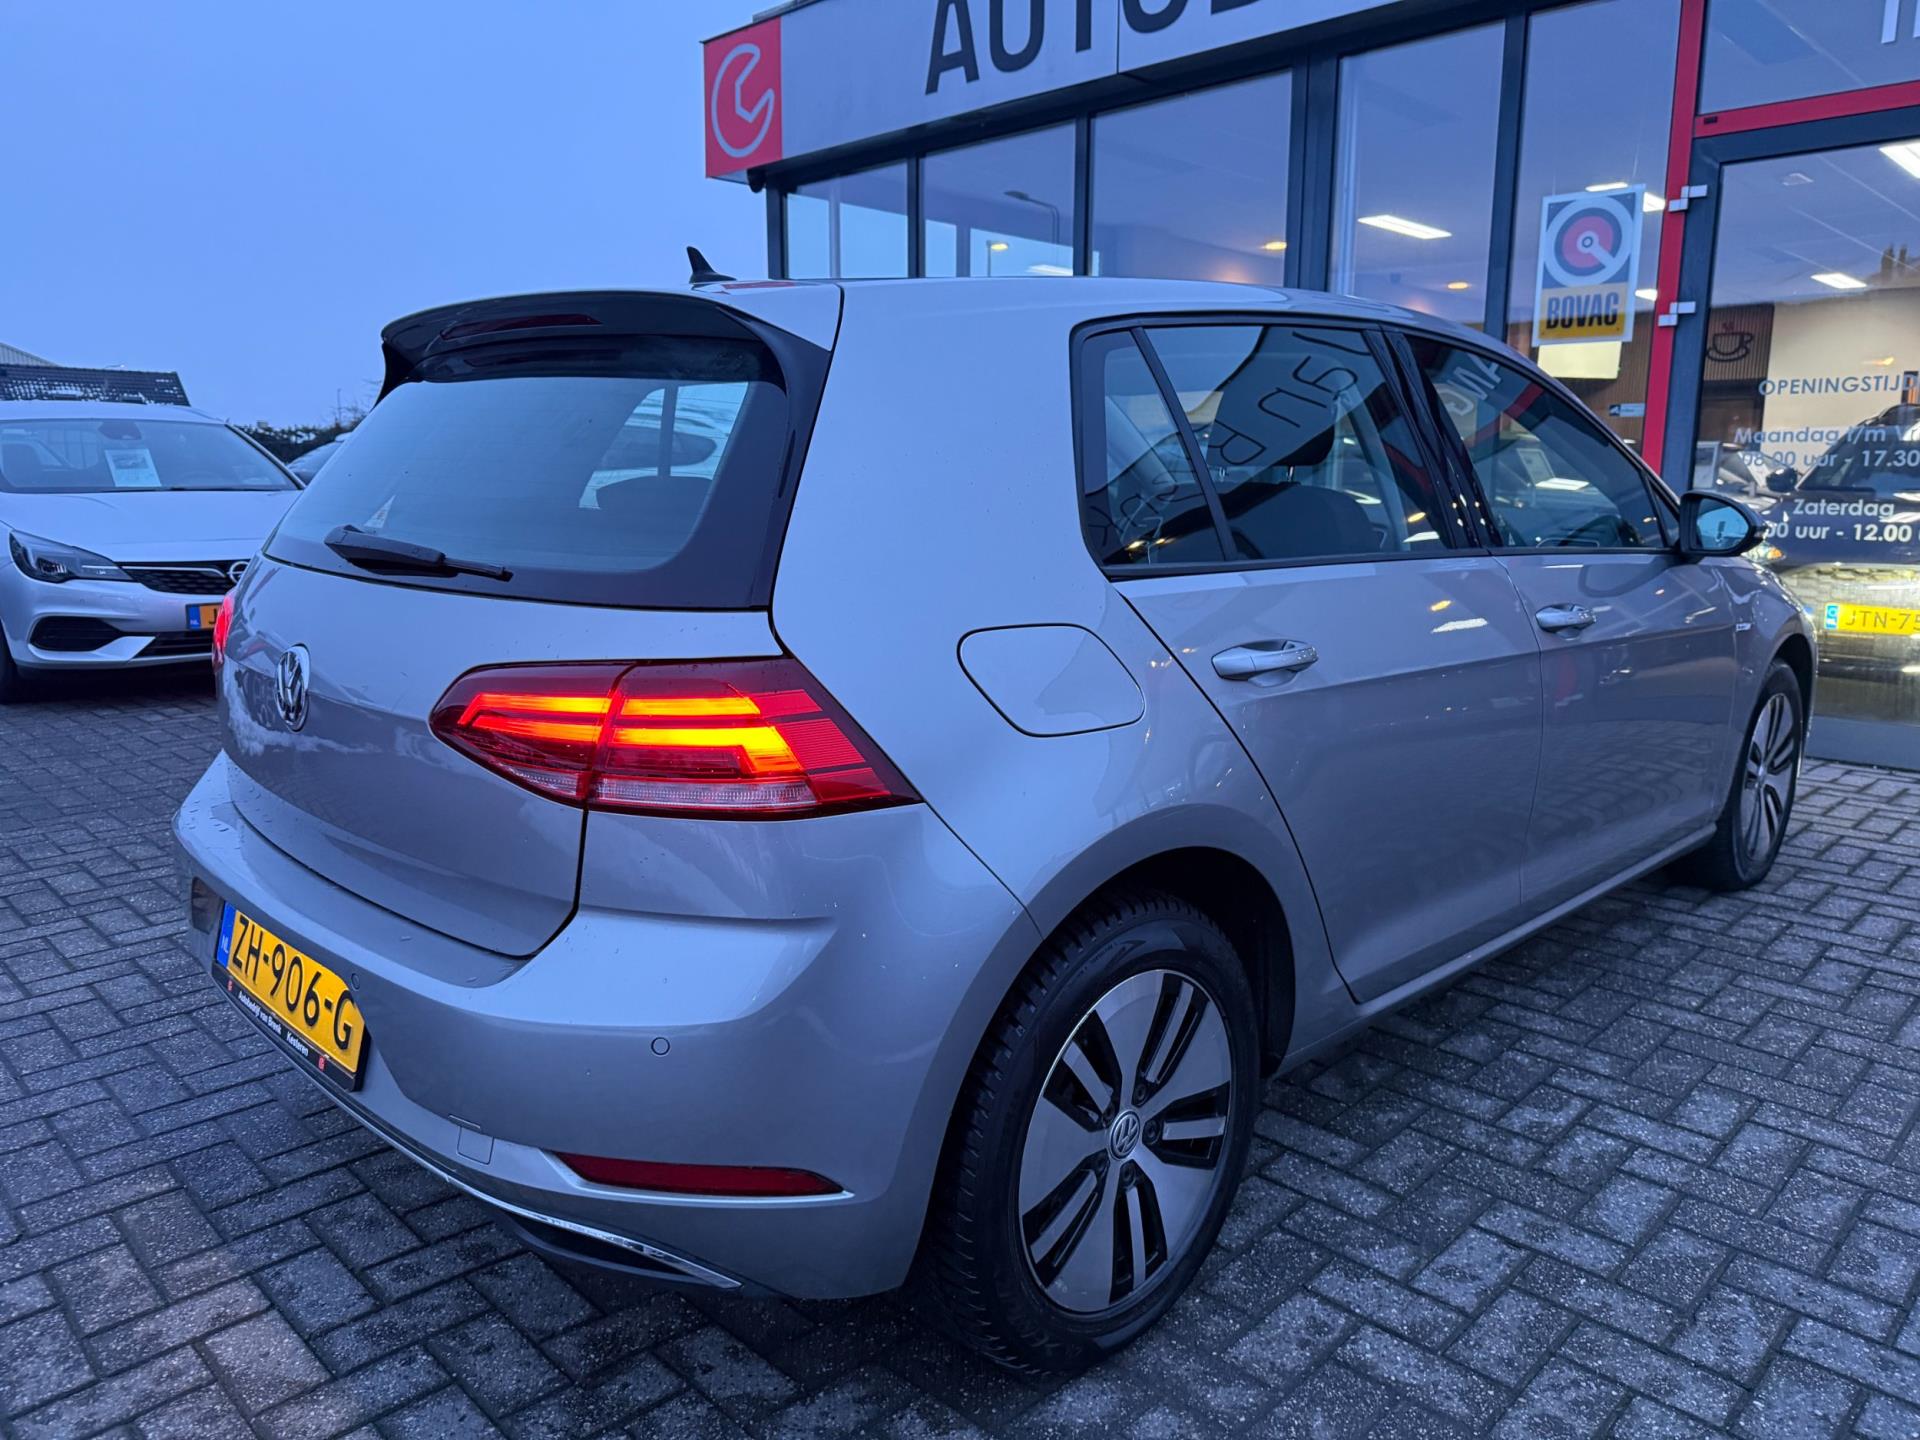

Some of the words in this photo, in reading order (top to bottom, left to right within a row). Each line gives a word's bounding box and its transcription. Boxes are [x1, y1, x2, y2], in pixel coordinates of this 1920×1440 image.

[1545, 291, 1620, 330] BOVAG
[1758, 373, 1918, 396] OPENINGSTIJD
[1733, 426, 1840, 446] Maandag
[1804, 454, 1838, 466] uur
[1862, 449, 1920, 467] 17.30
[1793, 498, 1895, 520] Zaterdag
[1795, 525, 1830, 540] uur
[1853, 523, 1913, 542] 12.00
[232, 914, 357, 1050] ZH-906-G
